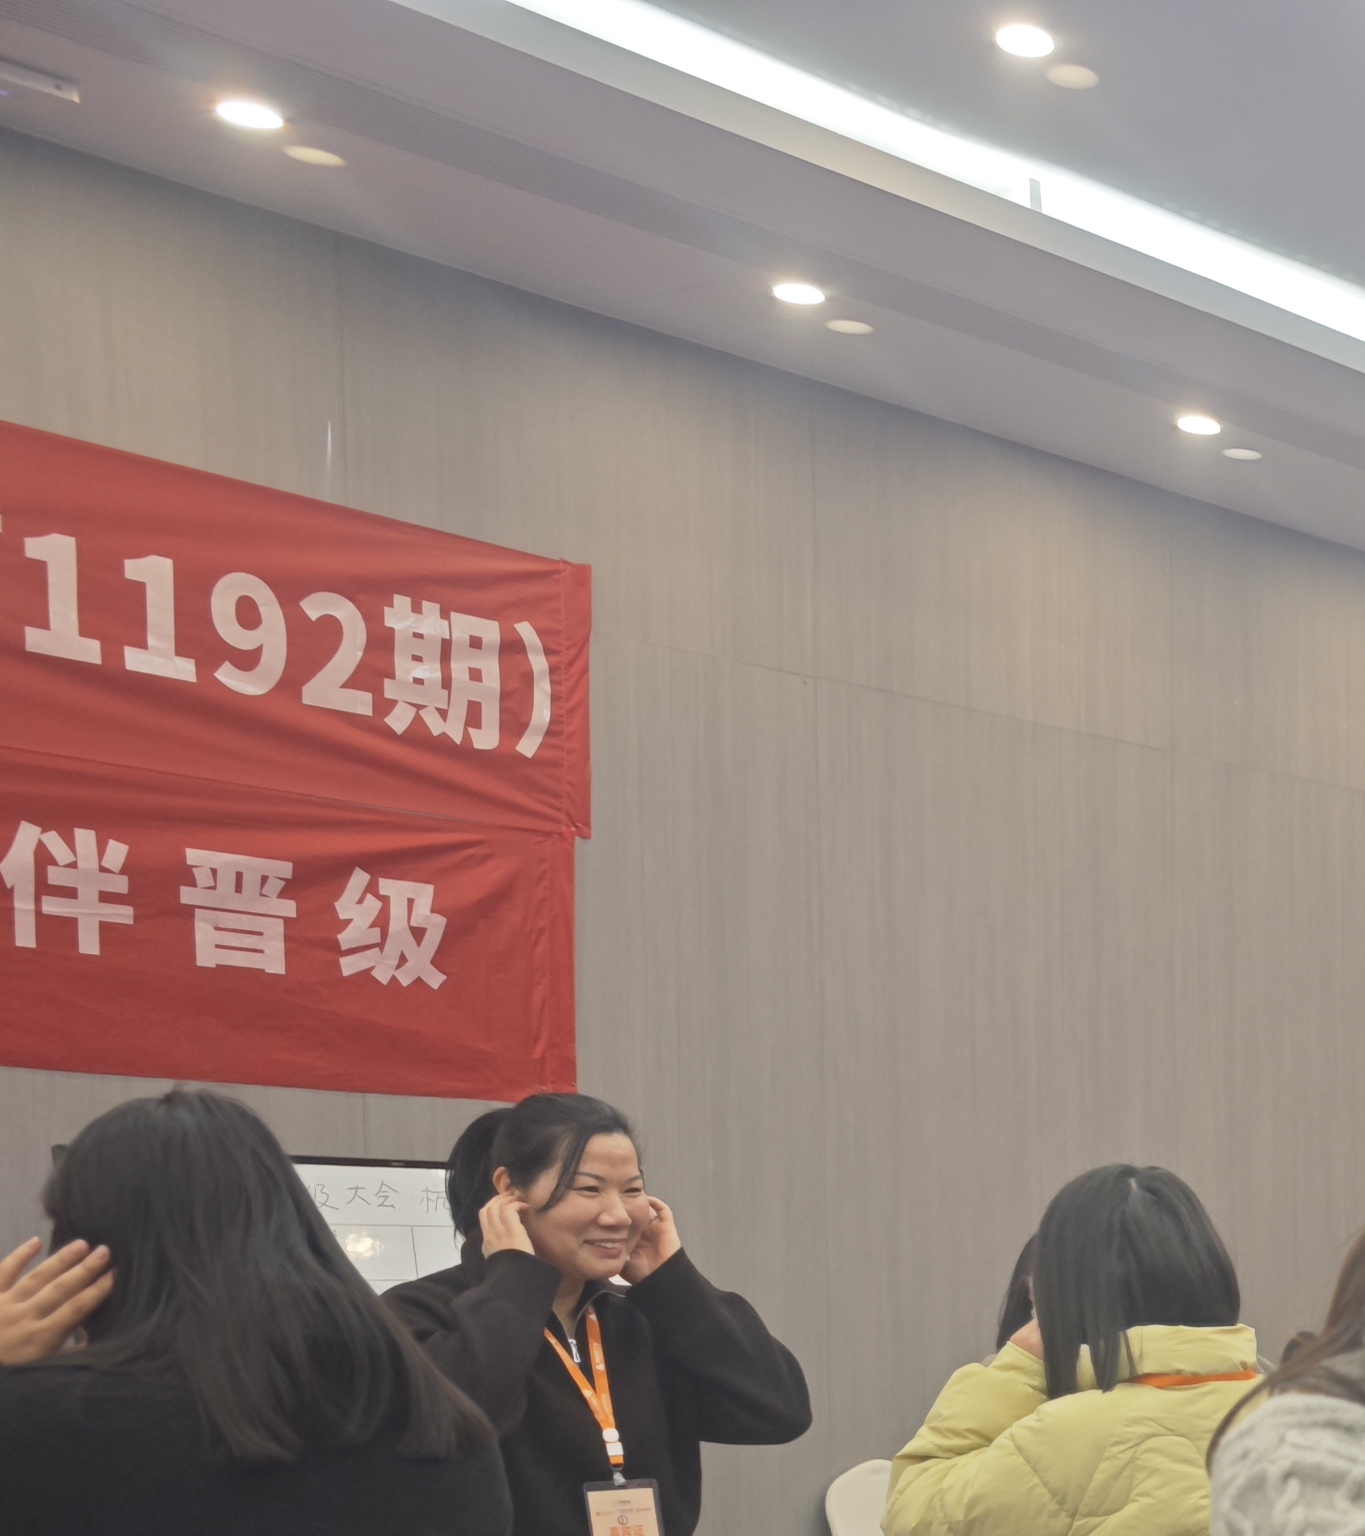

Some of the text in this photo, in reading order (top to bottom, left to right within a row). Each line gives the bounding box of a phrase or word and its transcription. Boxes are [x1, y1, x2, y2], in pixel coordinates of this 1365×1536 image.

[23, 533, 551, 759] 1192期)
[0, 820, 448, 990] 伴晋级
